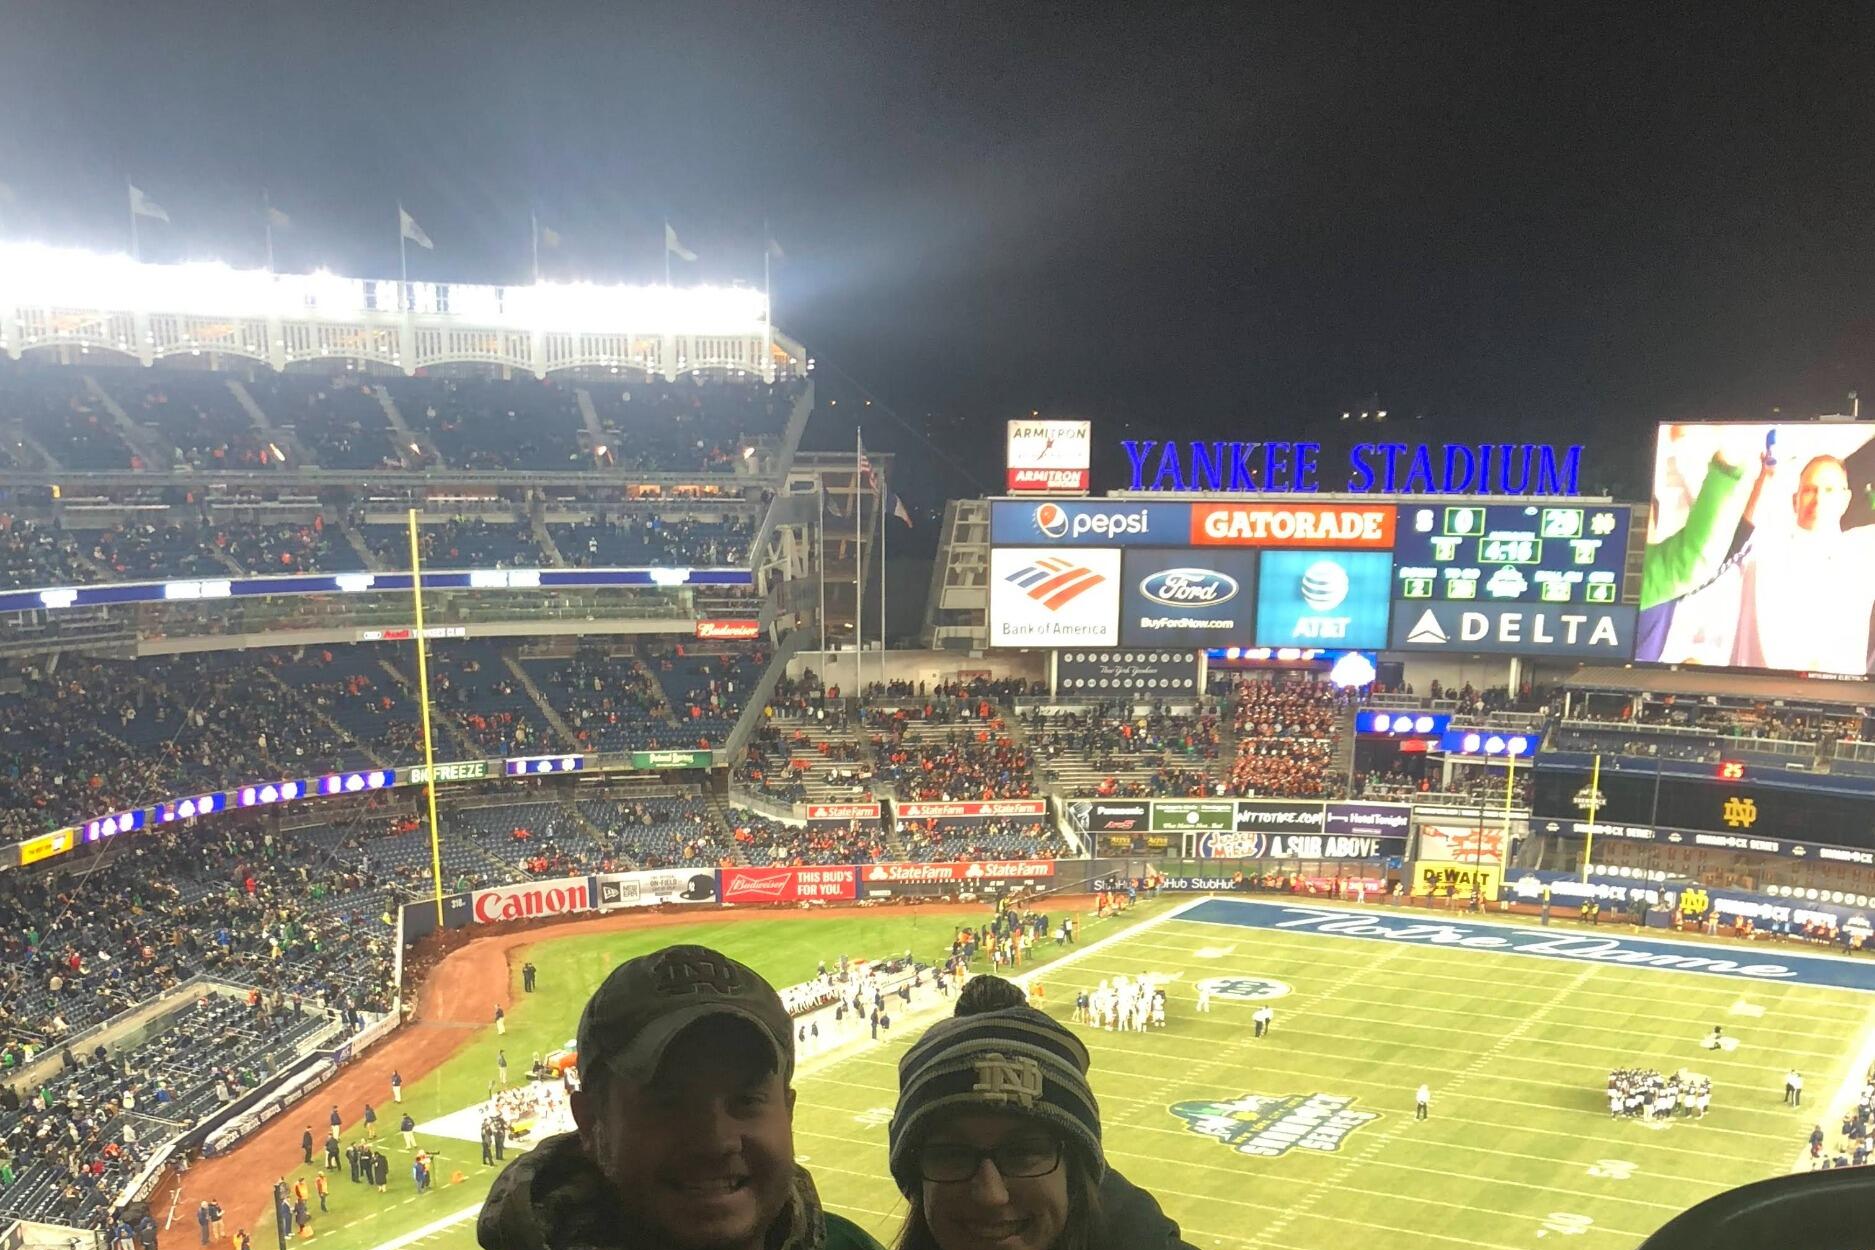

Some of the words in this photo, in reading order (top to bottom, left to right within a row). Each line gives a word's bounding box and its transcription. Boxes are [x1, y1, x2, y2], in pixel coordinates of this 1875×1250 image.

[1013, 428, 1087, 439] ARMITRON
[1015, 470, 1081, 482] ARMITRON
[1120, 440, 1320, 493] YANKEE
[1347, 442, 1585, 496] STADIUM
[1073, 509, 1149, 538] pepsi
[1205, 511, 1385, 539] GATORADE
[1159, 572, 1218, 600] Ford
[698, 622, 759, 637] Budweiser
[1002, 622, 1034, 635] Bank
[1037, 622, 1051, 635] of
[1053, 622, 1107, 635] America
[1140, 617, 1235, 630] BuyFordNow.com
[1293, 616, 1352, 639] AT&T
[1461, 612, 1619, 646] DELTA
[411, 761, 484, 783] BIFREEZE
[1270, 836, 1285, 858] A
[1288, 836, 1322, 858] SUB
[1325, 836, 1380, 858] ABOVE
[797, 871, 821, 883] THIS
[822, 870, 853, 882] BUD'S
[797, 884, 818, 896] FOR
[475, 884, 588, 925] Canon
[1276, 907, 1514, 948] Notre
[1511, 931, 1798, 978] Dame
